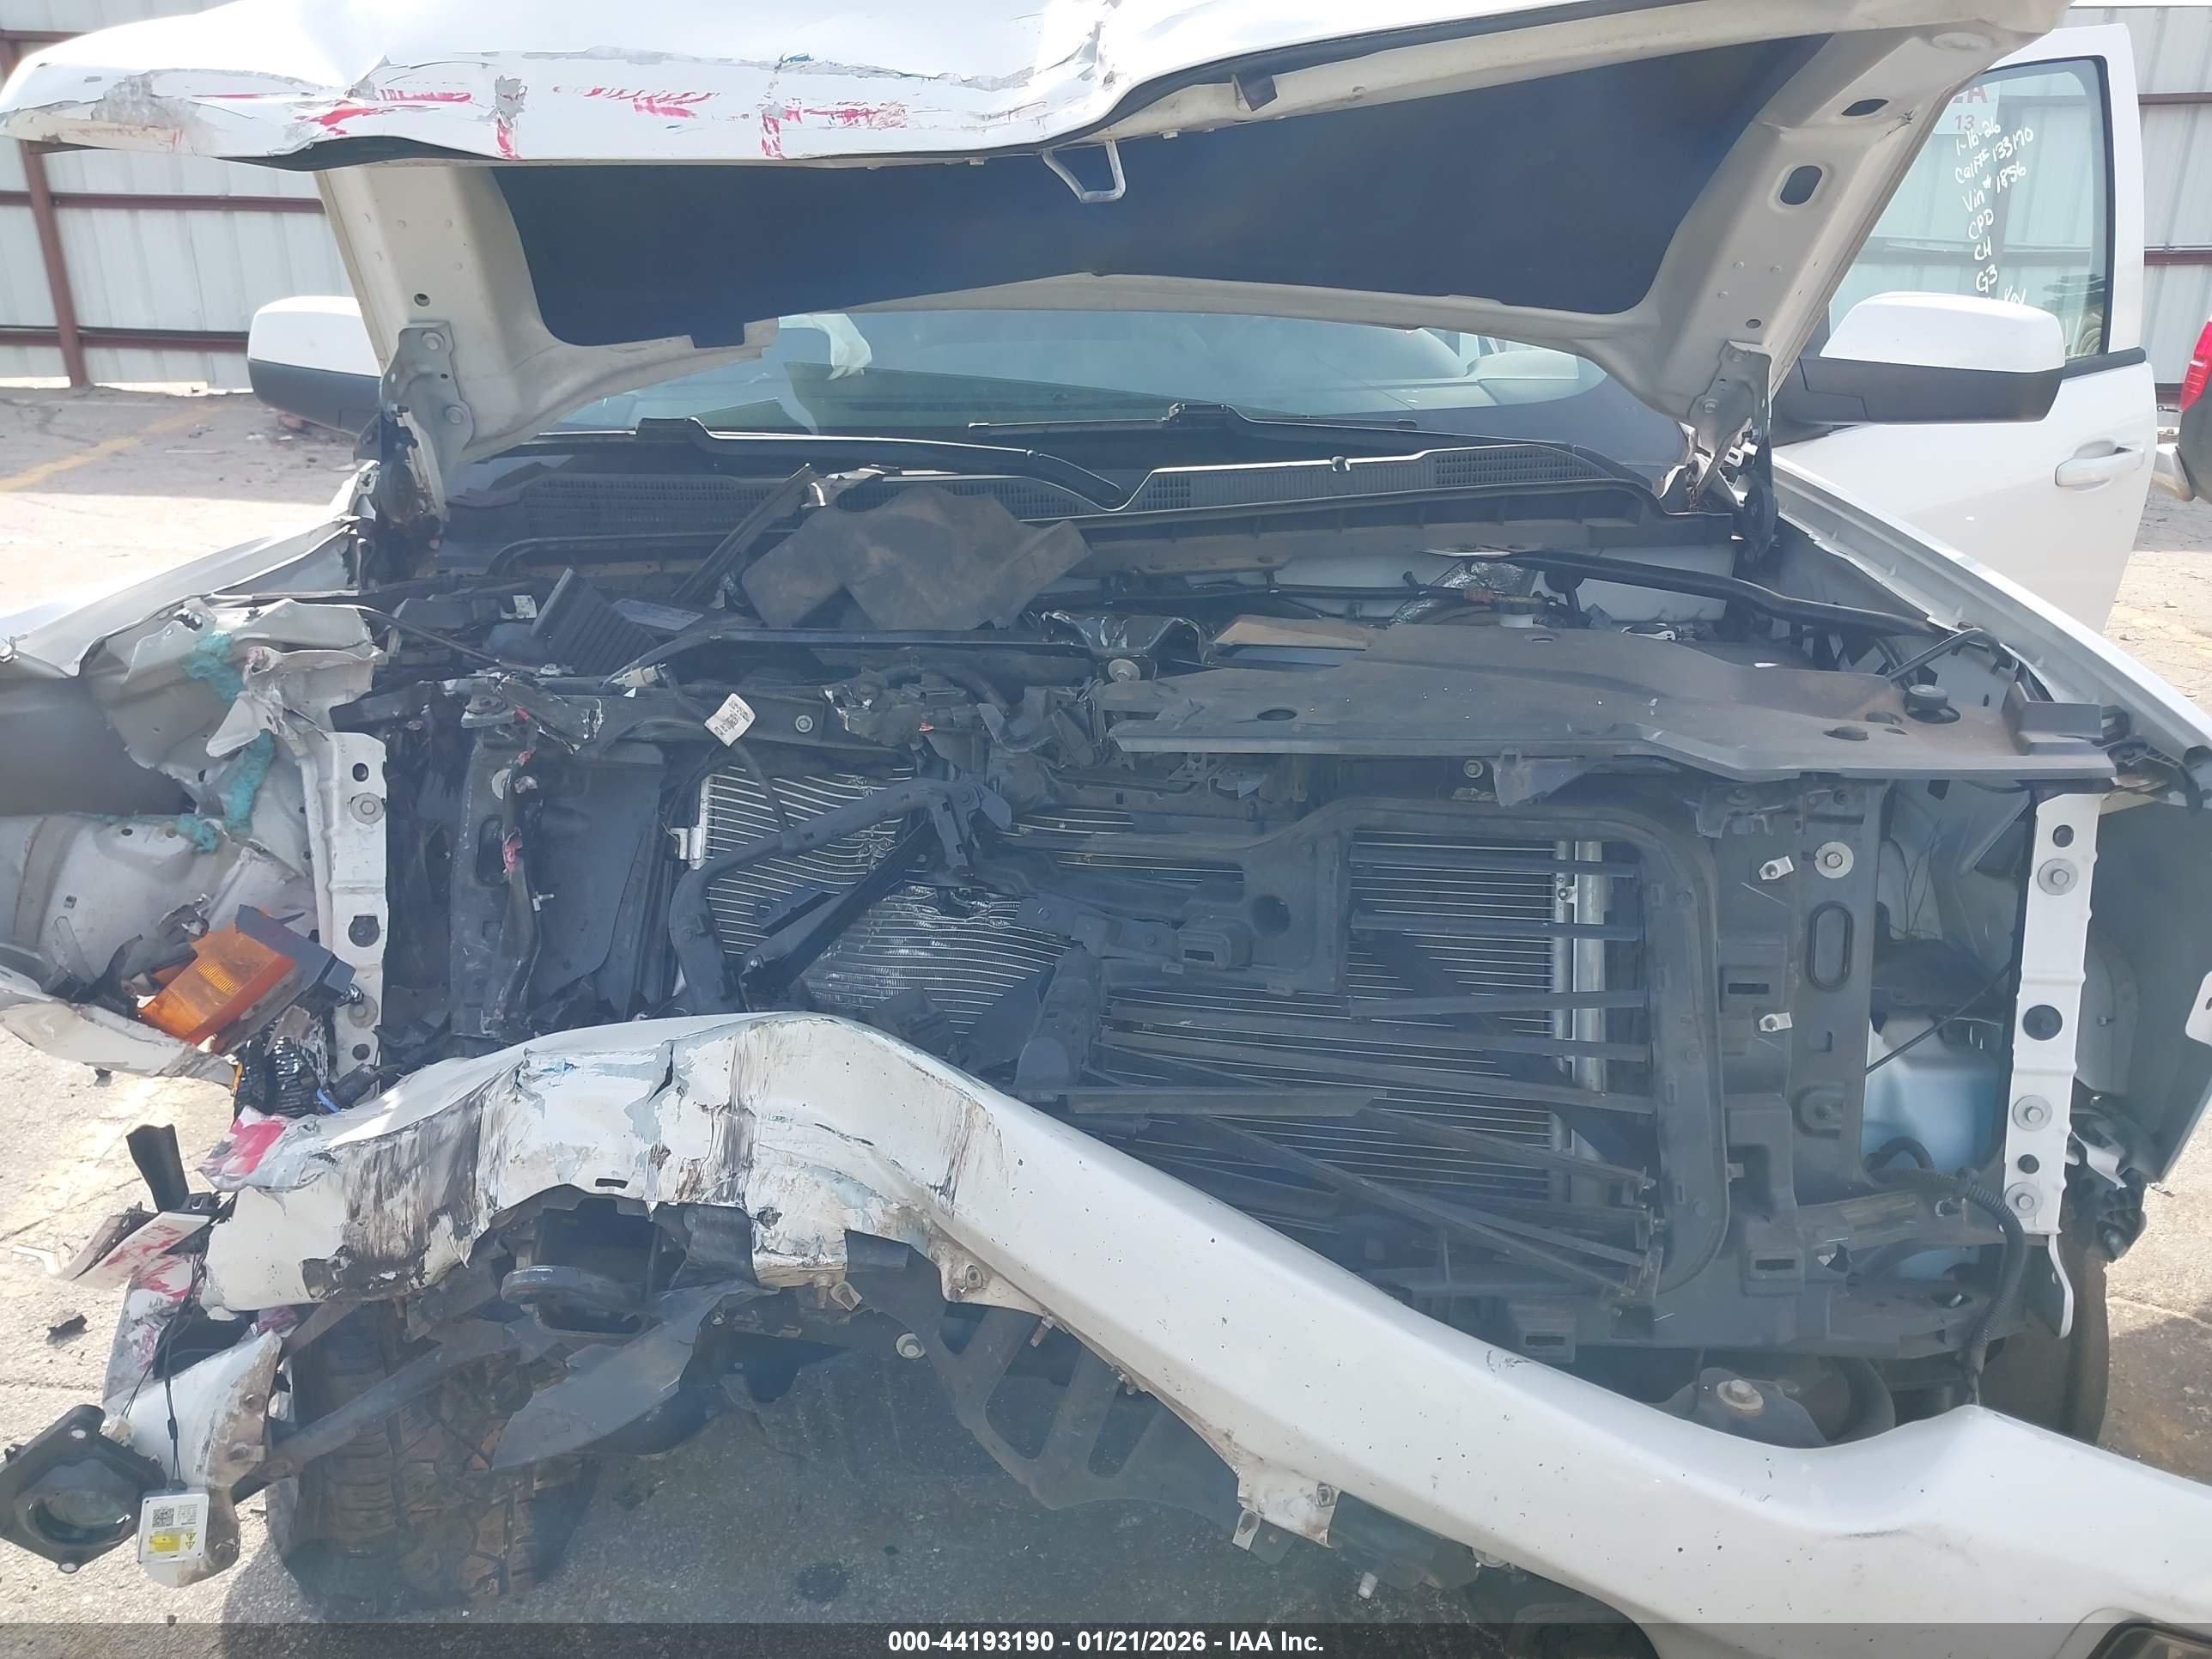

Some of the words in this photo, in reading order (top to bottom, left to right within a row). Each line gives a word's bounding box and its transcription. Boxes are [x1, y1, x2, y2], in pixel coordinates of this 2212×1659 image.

[1954, 114, 1975, 131] 13
[1997, 161, 2027, 194] 1856
[1968, 209, 1994, 240] CPD
[1974, 236, 1992, 261] CH
